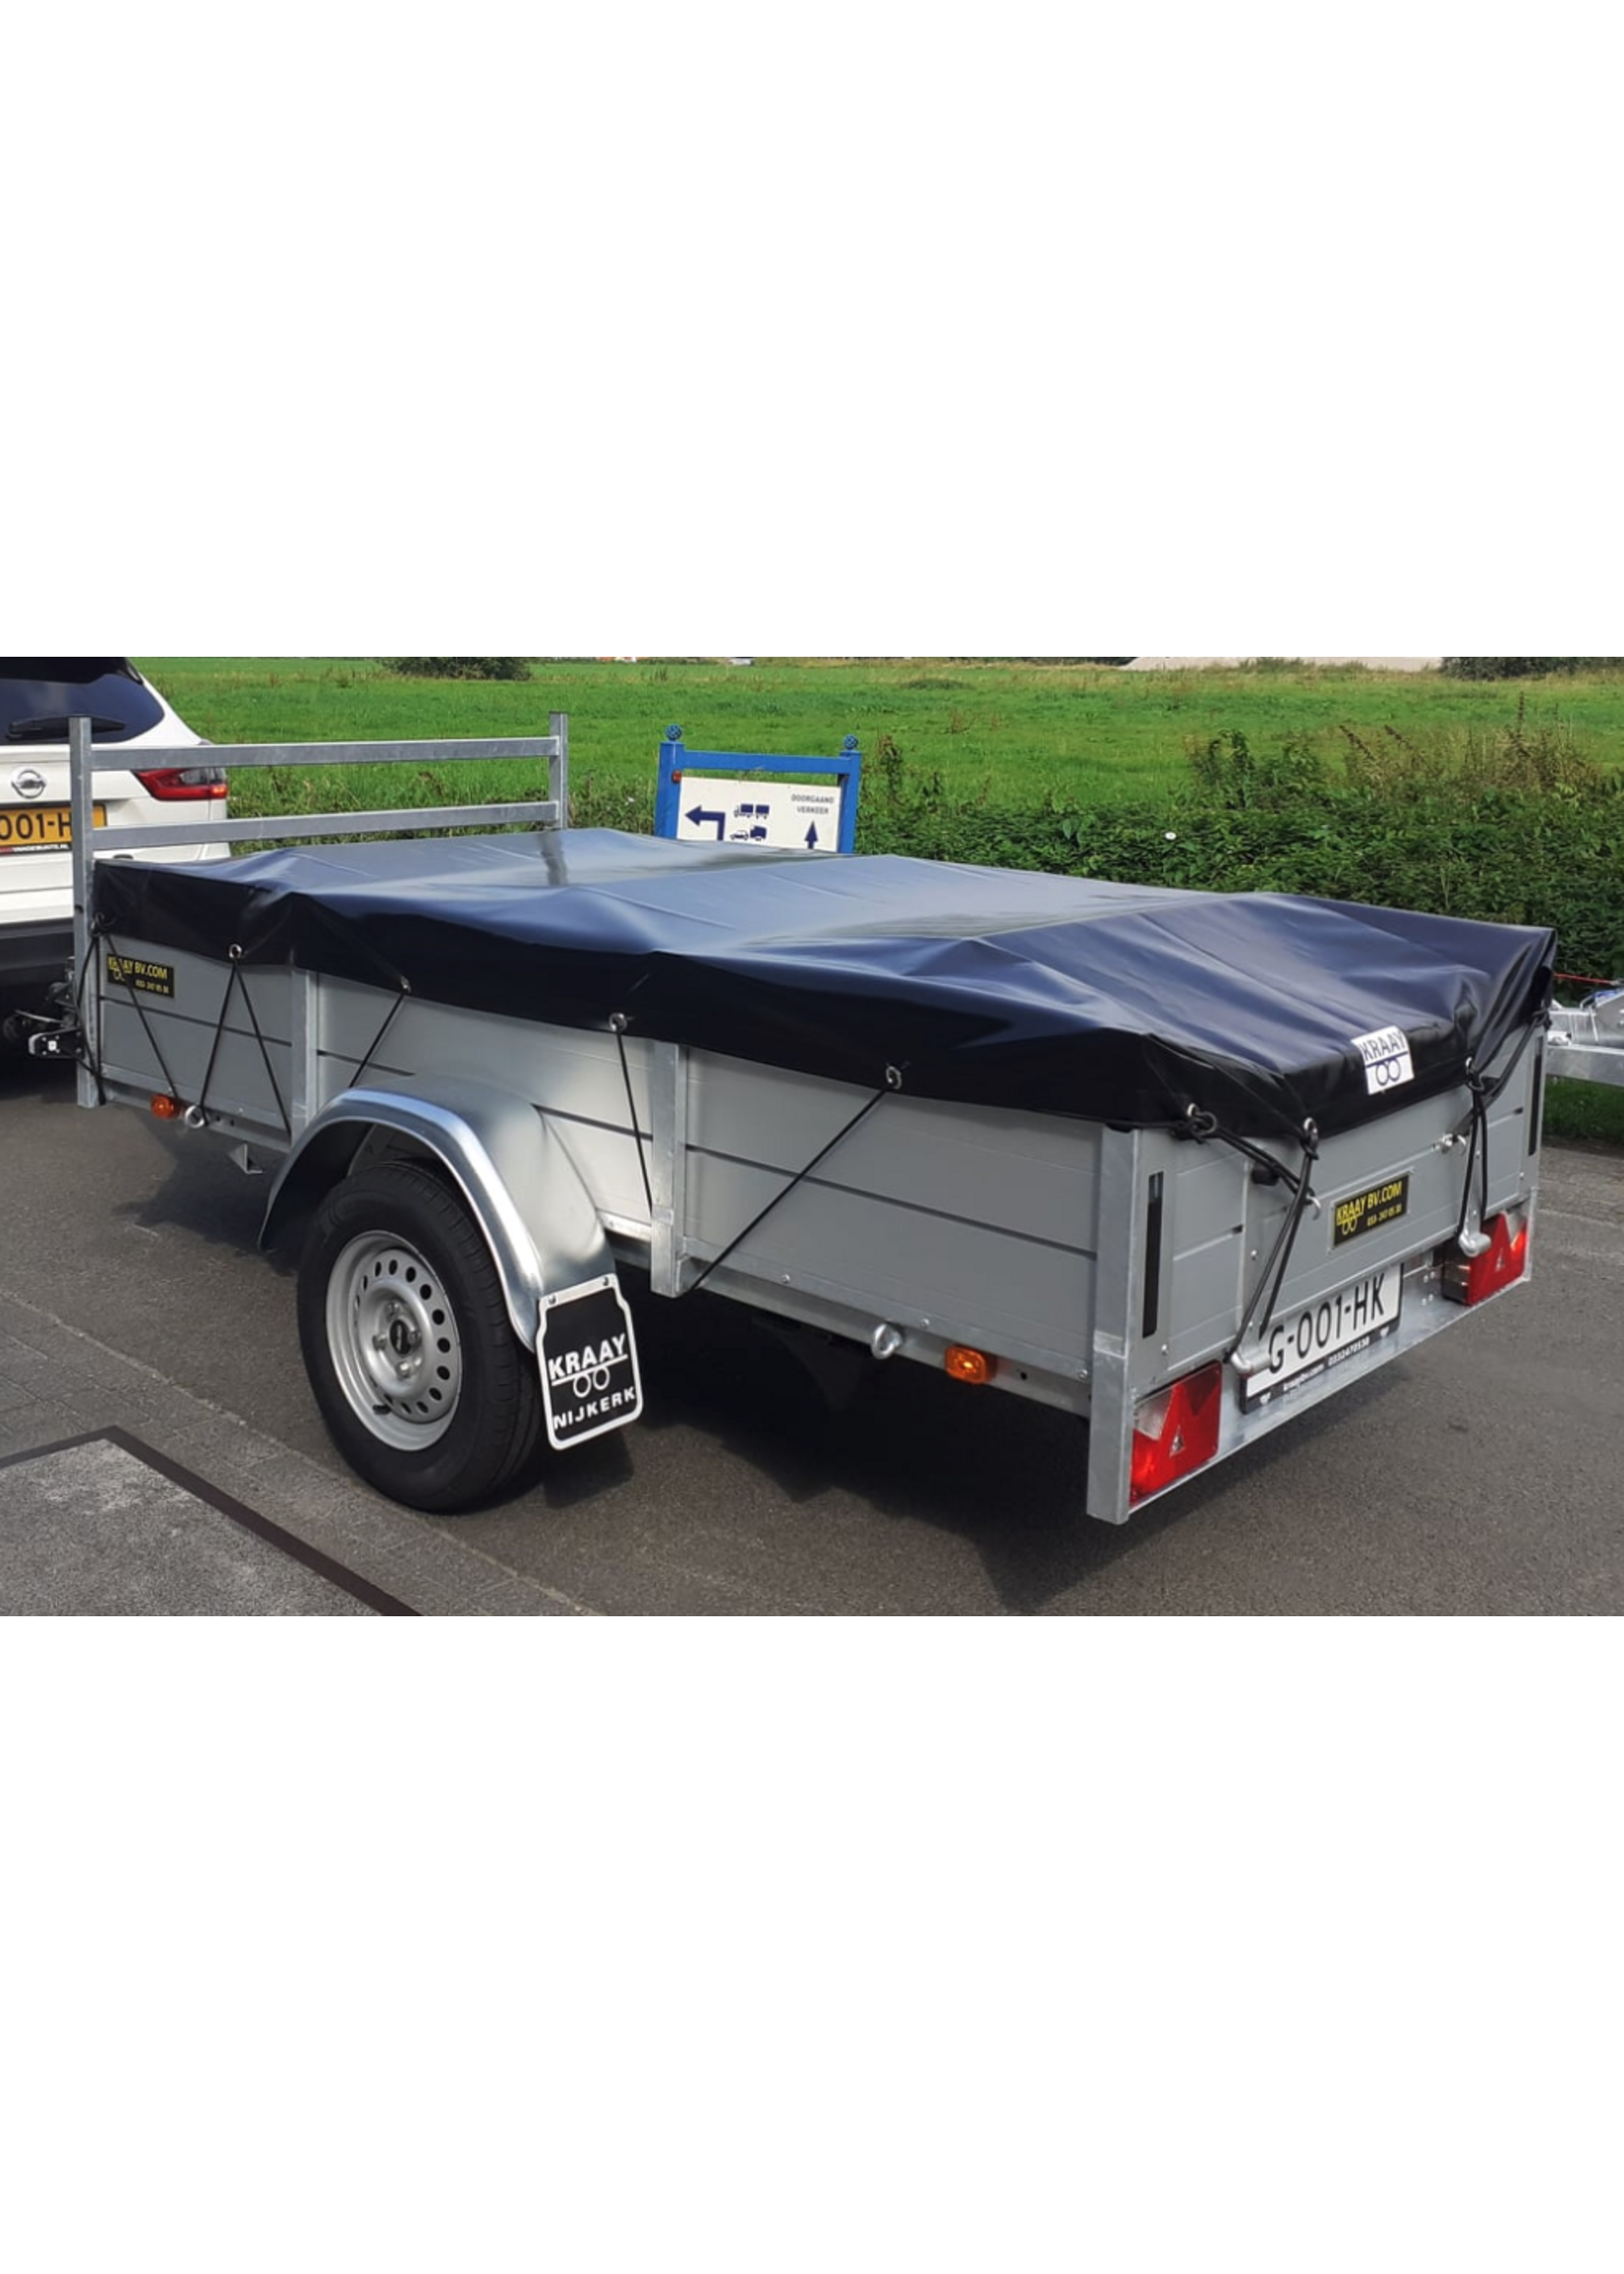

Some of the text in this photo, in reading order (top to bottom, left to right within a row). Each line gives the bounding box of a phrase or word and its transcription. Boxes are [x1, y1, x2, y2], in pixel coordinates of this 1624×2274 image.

[791, 793, 835, 804] DOORGAAND
[797, 805, 829, 815] VERKEER
[1359, 1030, 1406, 1062] KRAAY
[1337, 1180, 1403, 1222] KRAAY BV.COM
[1269, 1272, 1385, 1373] G-001-HK
[549, 1333, 625, 1380] KRAAY
[554, 1386, 636, 1430] NIJKERK
